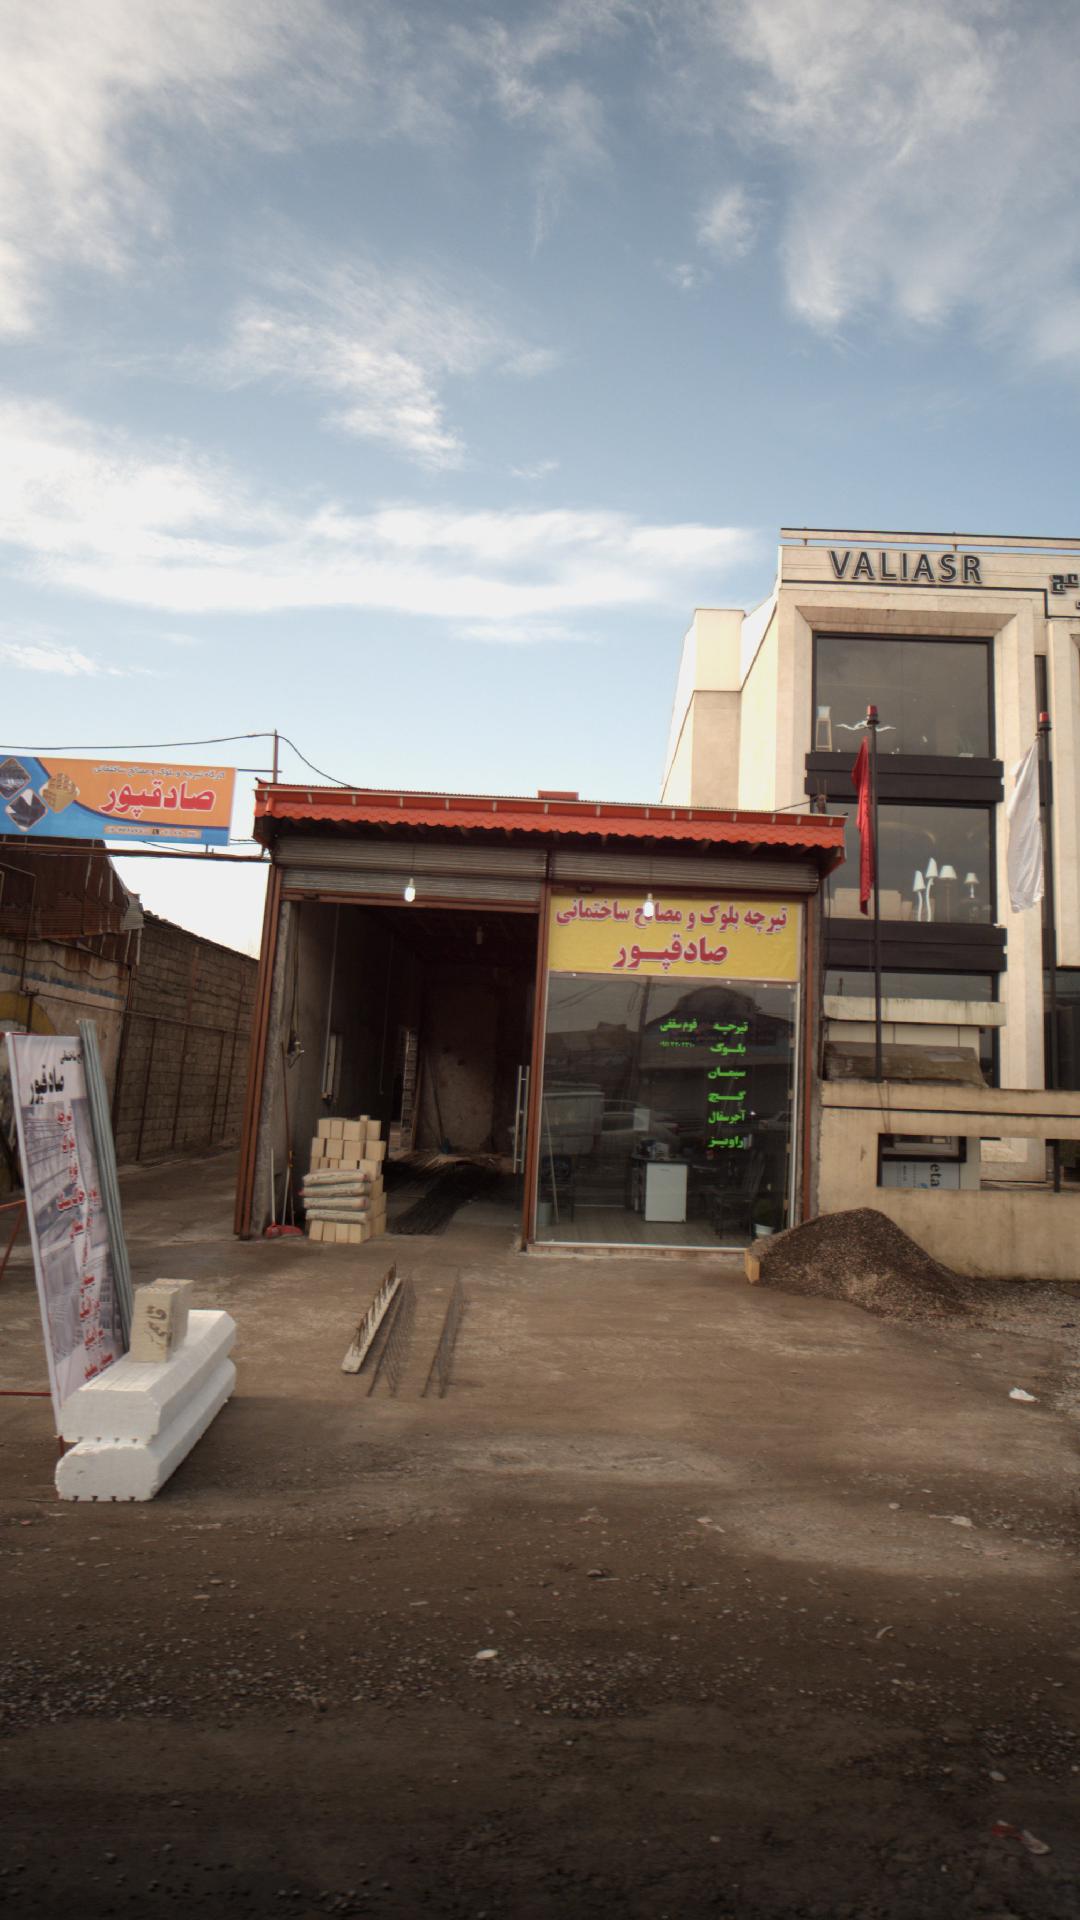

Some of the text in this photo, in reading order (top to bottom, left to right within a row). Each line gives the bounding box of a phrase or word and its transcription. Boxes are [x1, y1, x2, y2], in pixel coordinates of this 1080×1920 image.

[829, 550, 982, 583] VALIASR
[100, 780, 216, 817] صادقپور
[556, 897, 788, 933] تیرچه بلوک و مصاح ساختمانی
[612, 932, 728, 970] صادقپور
[710, 1043, 746, 1056] بلوک
